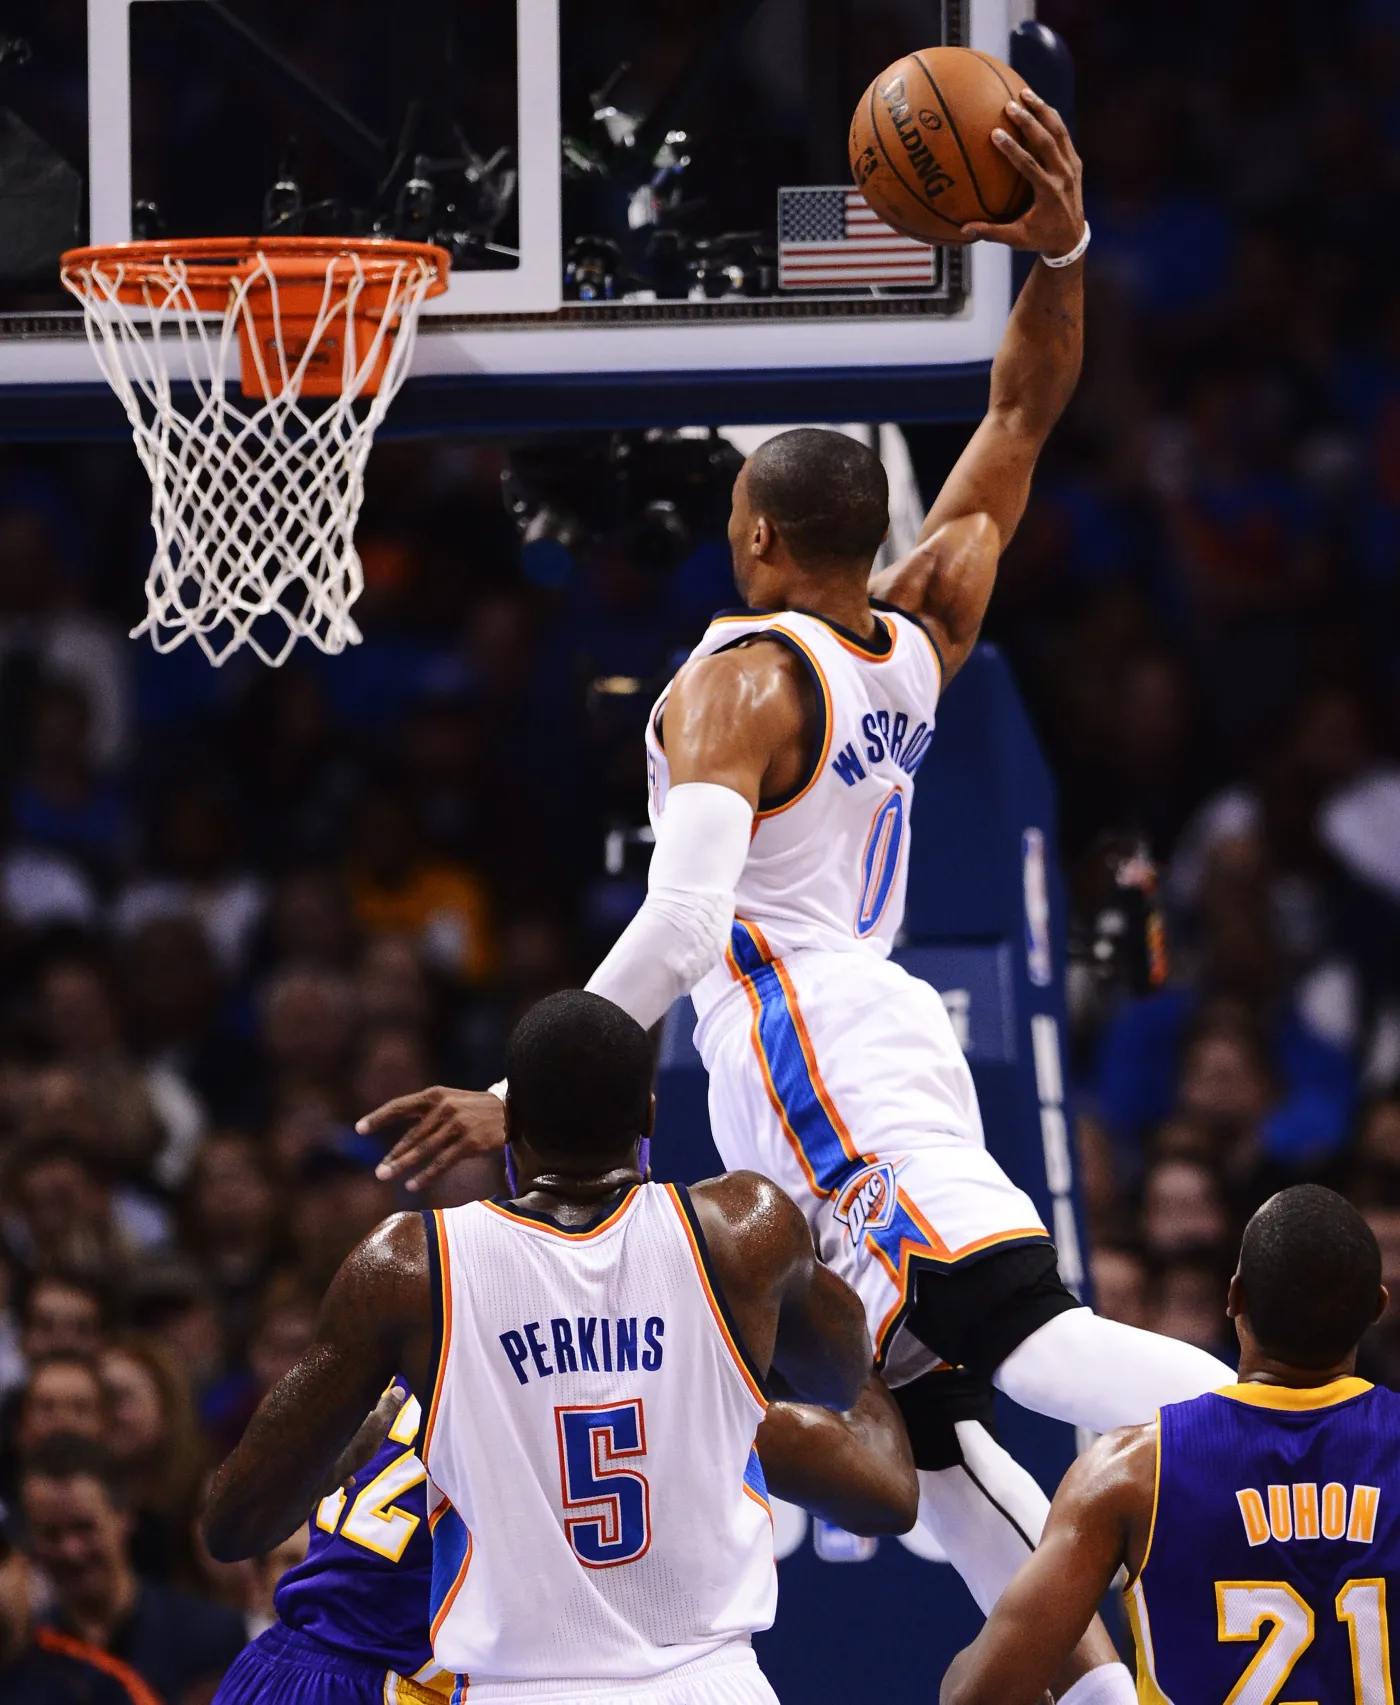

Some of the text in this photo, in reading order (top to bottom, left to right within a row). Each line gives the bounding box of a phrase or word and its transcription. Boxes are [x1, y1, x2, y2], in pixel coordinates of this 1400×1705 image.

[880, 75, 956, 198] SPALDING
[853, 784, 904, 939] 0
[847, 1173, 882, 1247] OKC
[499, 1316, 665, 1385] PERKINS
[553, 1398, 651, 1570] 5
[1235, 1482, 1381, 1546] DUHON
[1214, 1577, 1394, 1705] 21
